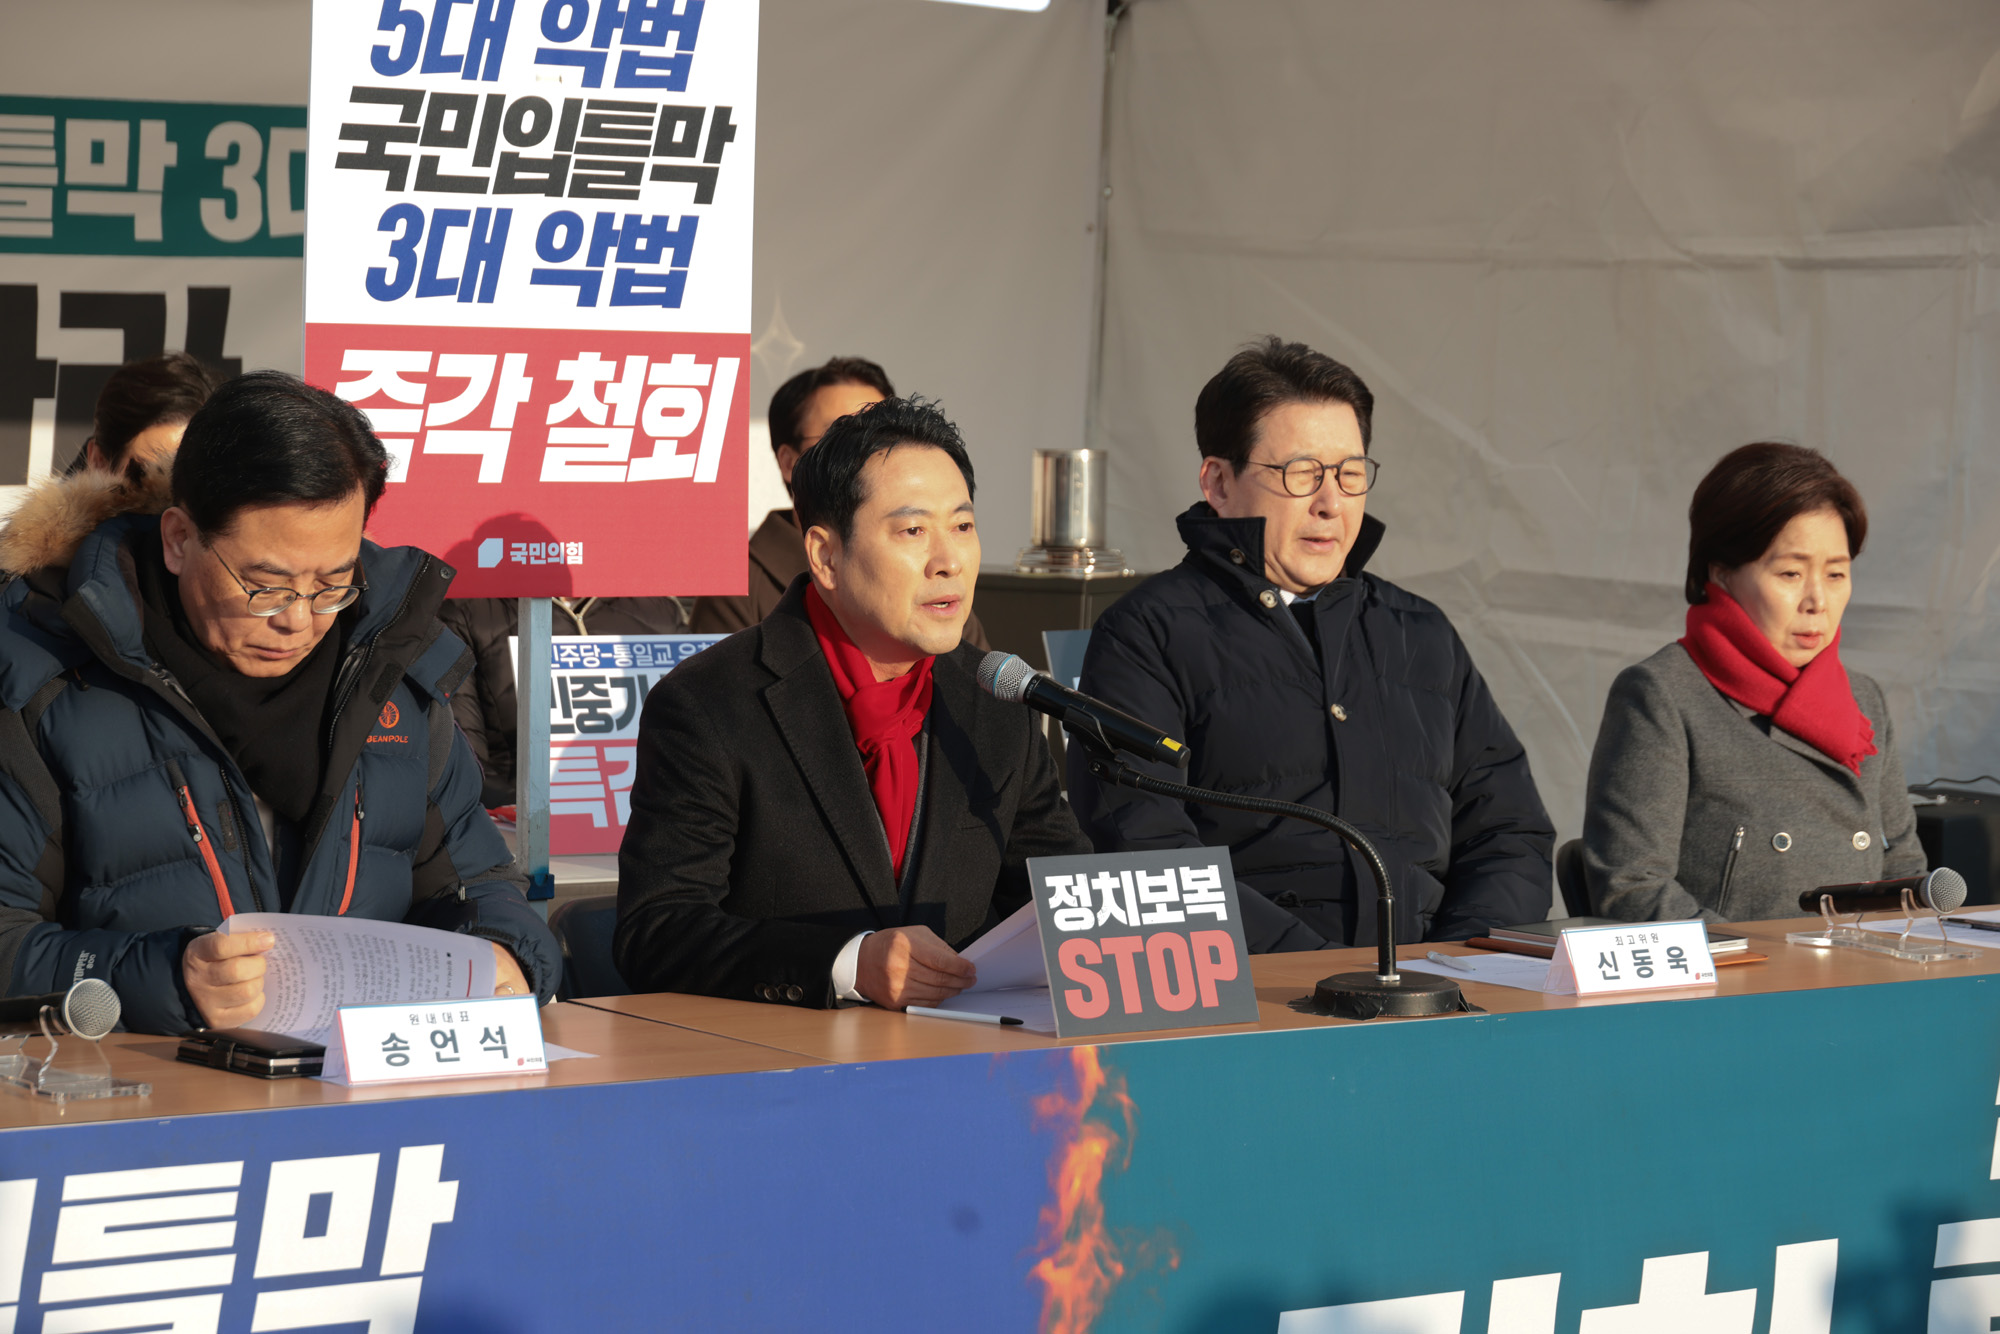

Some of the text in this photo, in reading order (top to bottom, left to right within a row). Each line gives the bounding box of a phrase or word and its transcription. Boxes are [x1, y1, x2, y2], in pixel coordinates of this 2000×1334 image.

[370, 0, 705, 92] 5대 악법
[334, 86, 738, 205] 국민입틀막
[365, 202, 700, 309] 3대 악법
[335, 349, 741, 483] 즉각 철회
[510, 542, 583, 565] 국민의힘
[366, 734, 409, 743] BEANPOLE
[1045, 864, 1229, 932] 정치보복
[73, 950, 90, 985] TOPPER
[1058, 929, 1239, 1020] STOP
[0, 1143, 460, 1334] 틀막
